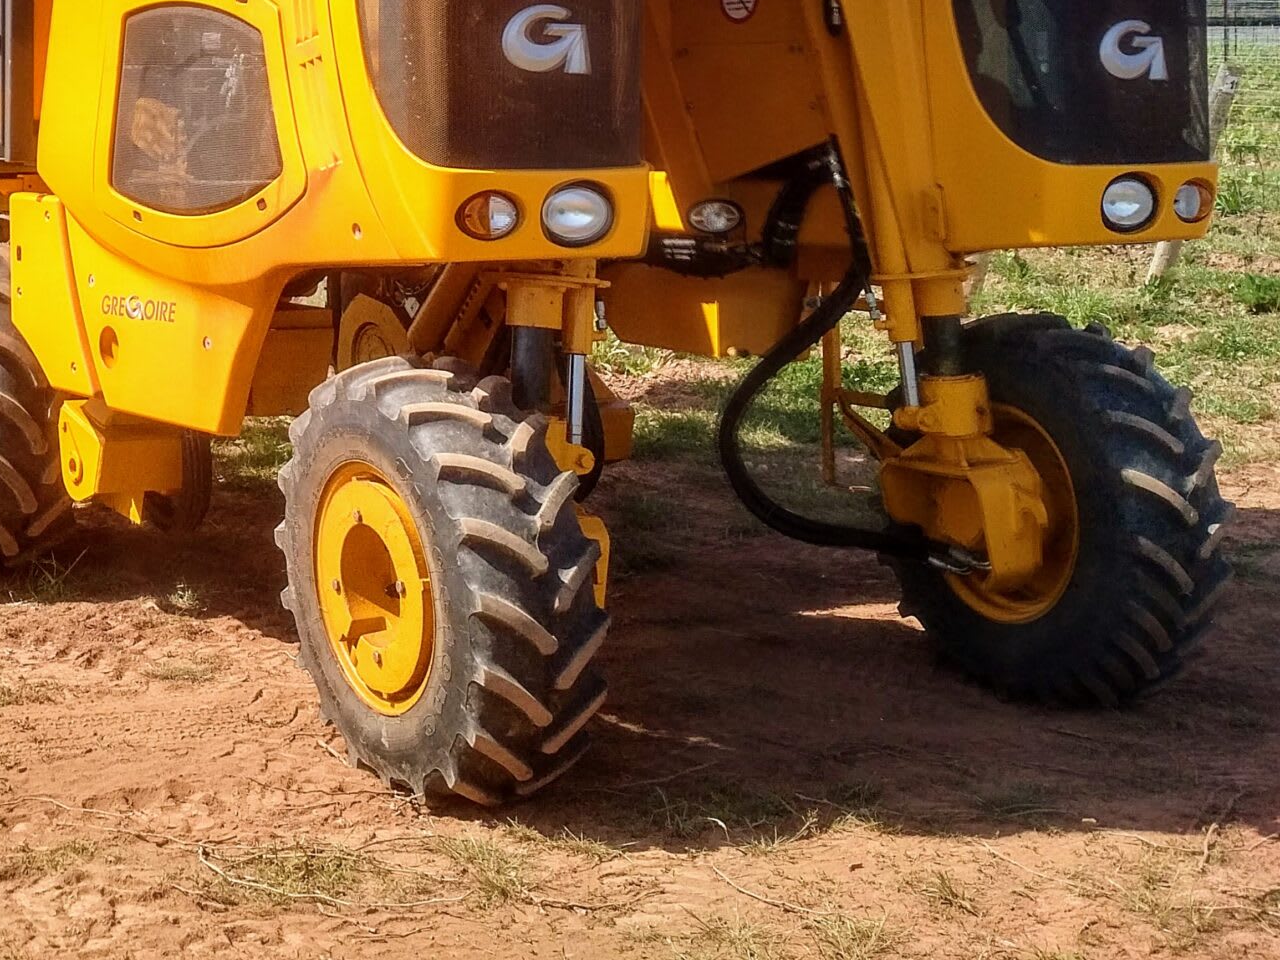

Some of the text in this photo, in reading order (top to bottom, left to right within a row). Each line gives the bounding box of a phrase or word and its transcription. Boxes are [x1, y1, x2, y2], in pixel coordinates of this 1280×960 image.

[502, 4, 592, 74] G
[1100, 19, 1169, 80] G
[100, 294, 177, 323] GREGOIRE
